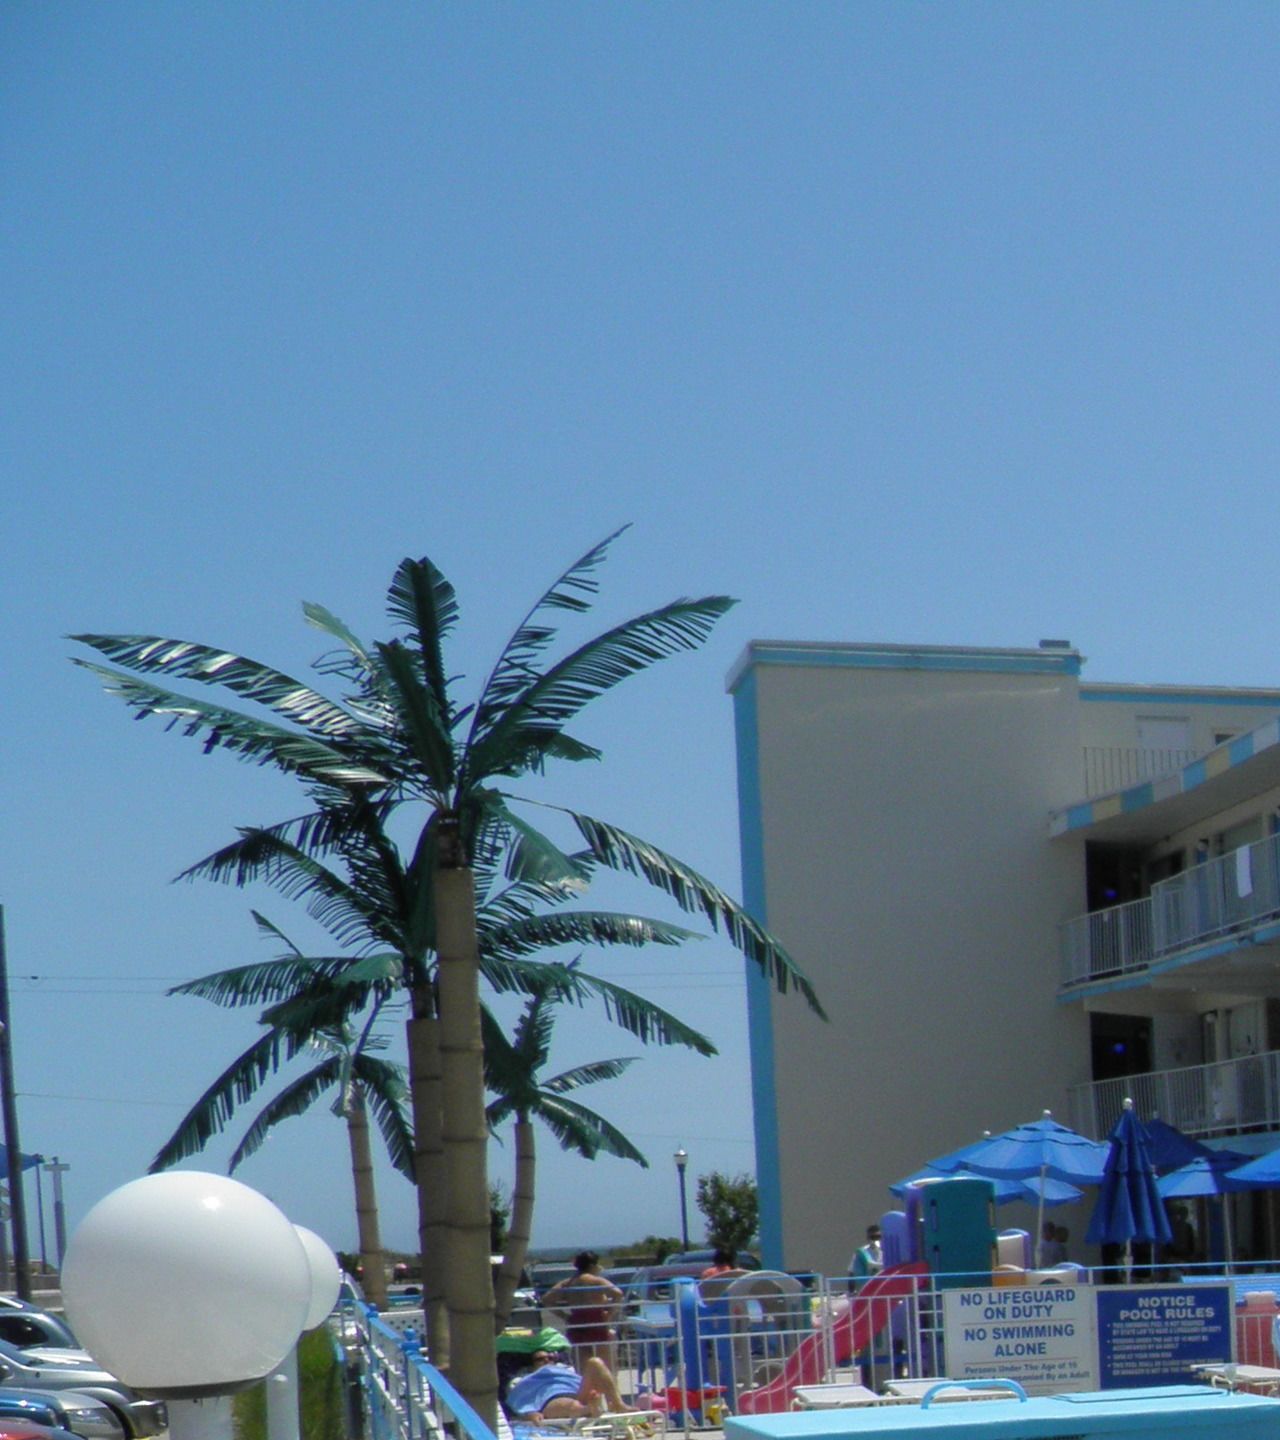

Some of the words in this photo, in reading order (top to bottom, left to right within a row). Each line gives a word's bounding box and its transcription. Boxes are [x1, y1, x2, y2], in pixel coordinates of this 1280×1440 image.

[960, 1294, 983, 1306] NO
[988, 1289, 1075, 1305] LIFEGUARD
[1138, 1296, 1195, 1307] NOTICE
[984, 1307, 1006, 1320] ON
[1012, 1305, 1053, 1319] DUTY
[1119, 1309, 1161, 1320] POOL
[1165, 1307, 1215, 1319] RULES
[964, 1328, 987, 1341] NO
[992, 1324, 1075, 1339] SWIMMING
[995, 1342, 1047, 1357] ALONE
[965, 1366, 996, 1374] Persons
[998, 1365, 1022, 1373] Under
[1041, 1363, 1056, 1372] Age
